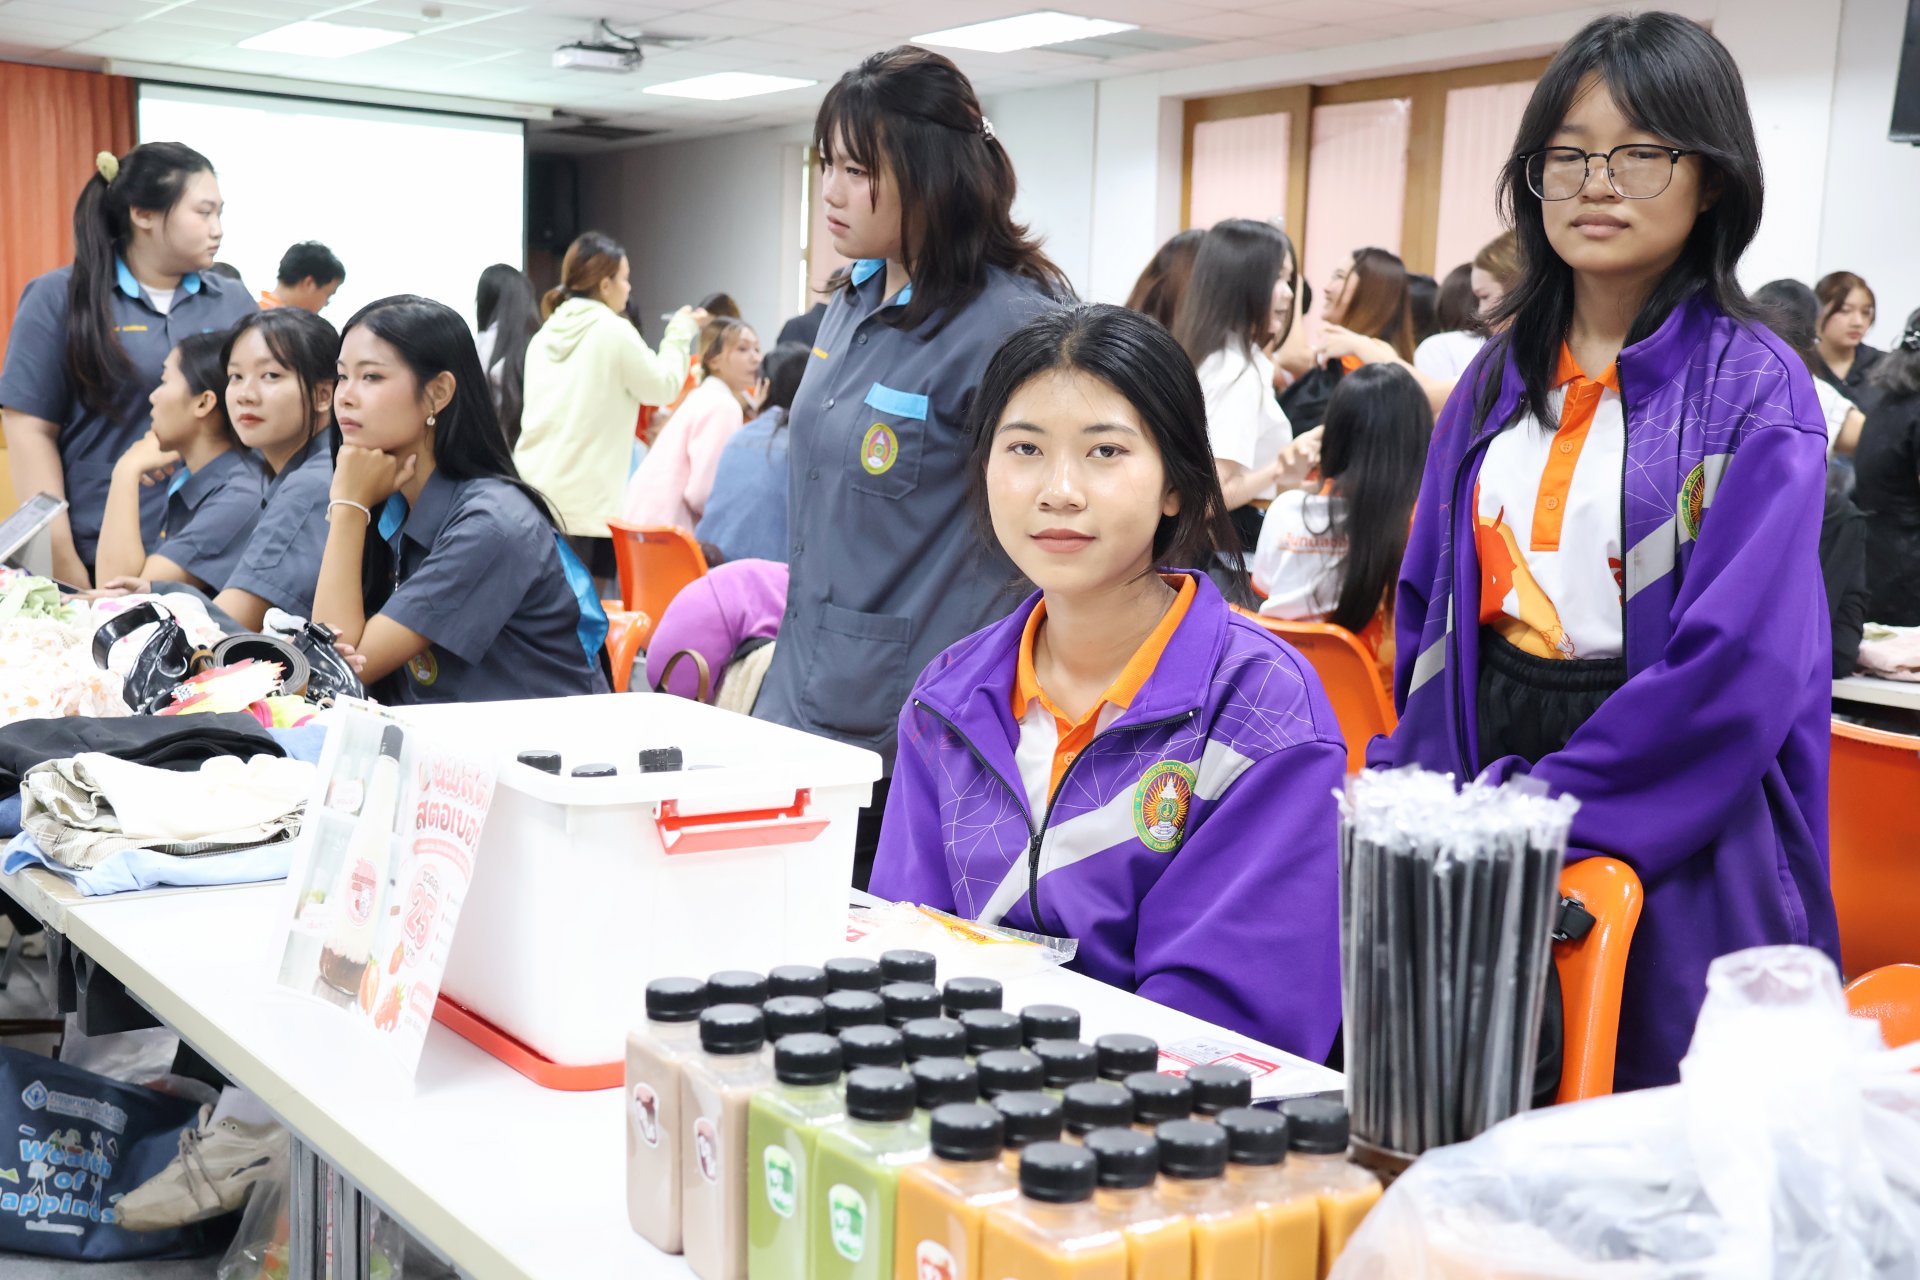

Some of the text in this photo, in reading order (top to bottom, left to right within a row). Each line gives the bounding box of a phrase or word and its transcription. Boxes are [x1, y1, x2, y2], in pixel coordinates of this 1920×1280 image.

[404, 883, 437, 950] 25
[19, 1139, 112, 1179] Wealth
[54, 1171, 87, 1191] of
